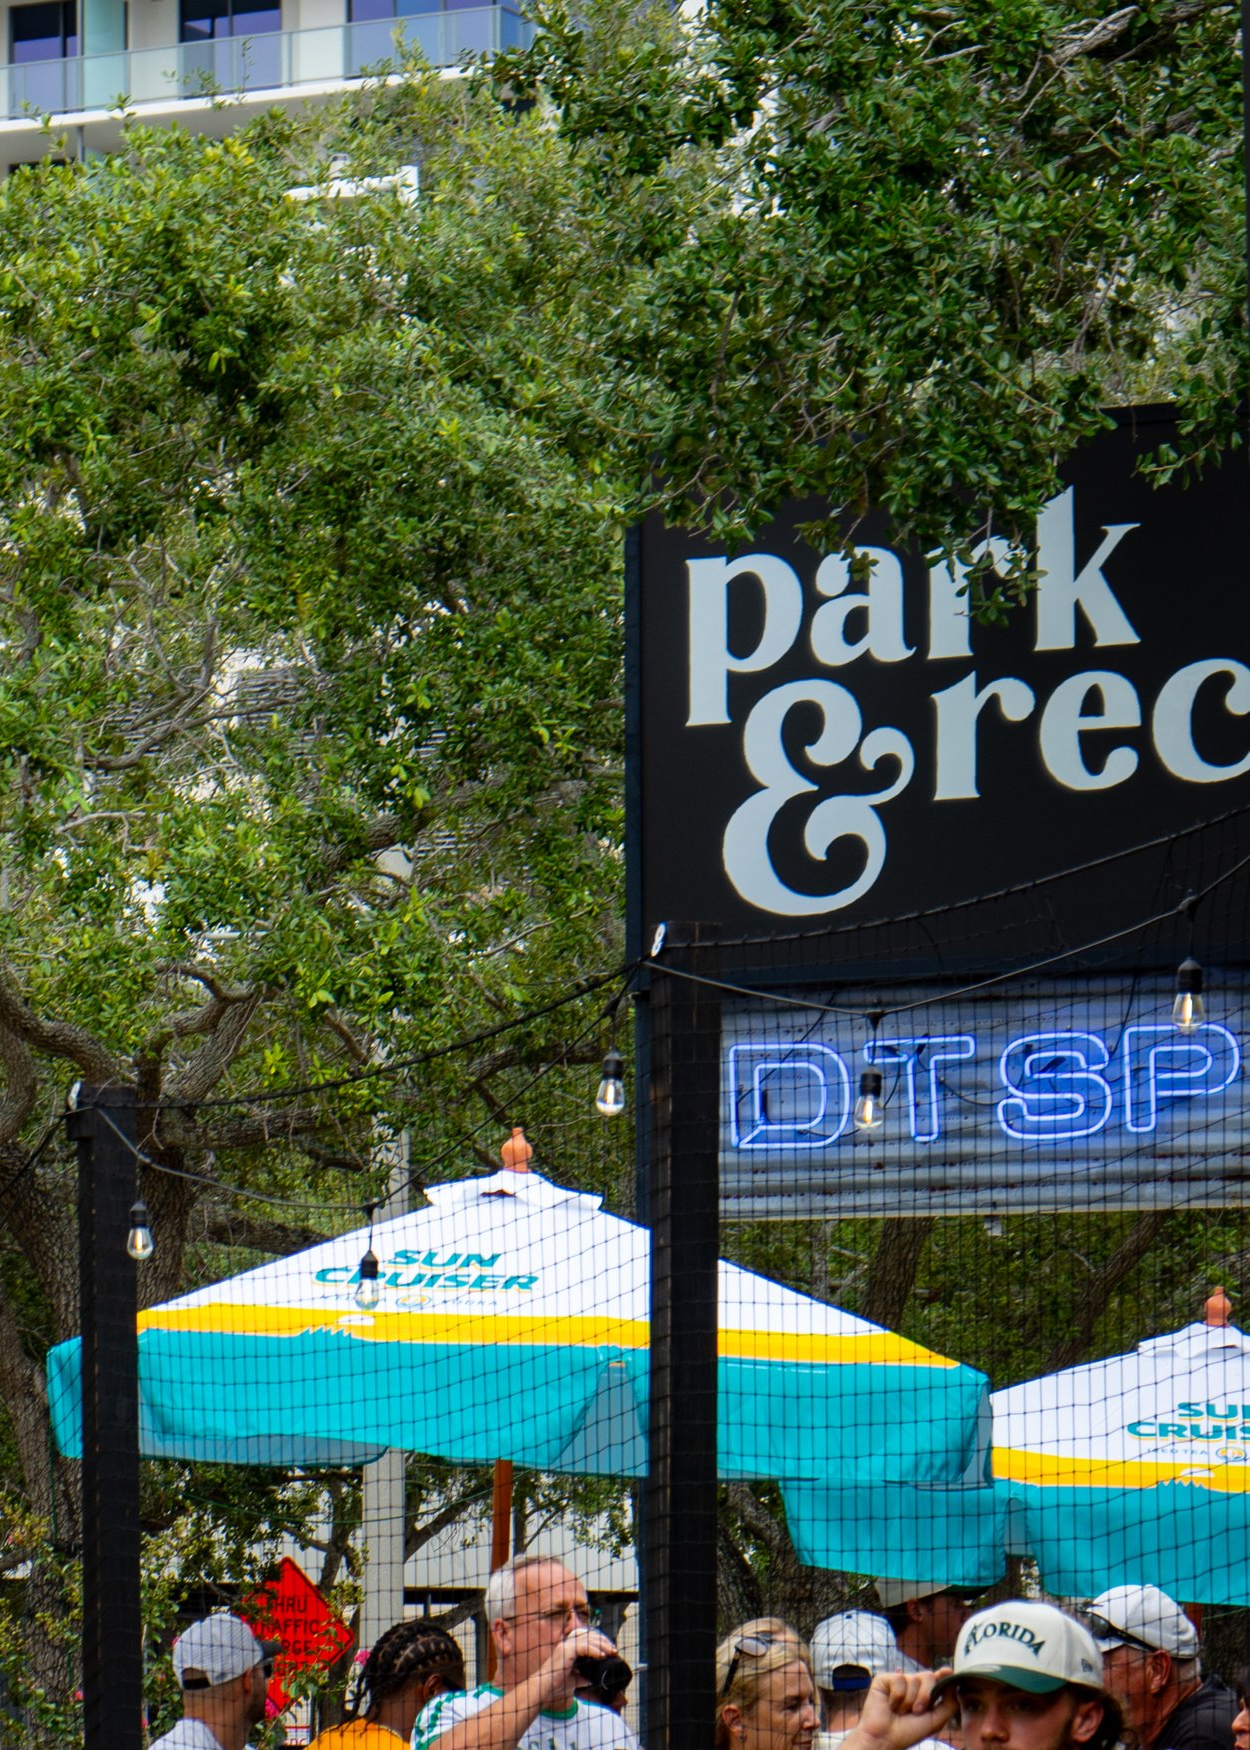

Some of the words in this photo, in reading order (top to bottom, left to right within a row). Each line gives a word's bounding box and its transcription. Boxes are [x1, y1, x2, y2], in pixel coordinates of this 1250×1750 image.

[685, 484, 1142, 727] park
[728, 1023, 1241, 1150] DTSP
[386, 1249, 501, 1271] SUN
[1177, 1402, 1250, 1421] SU
[273, 1597, 308, 1613] HRU
[964, 1621, 1046, 1659] FLORIDA
